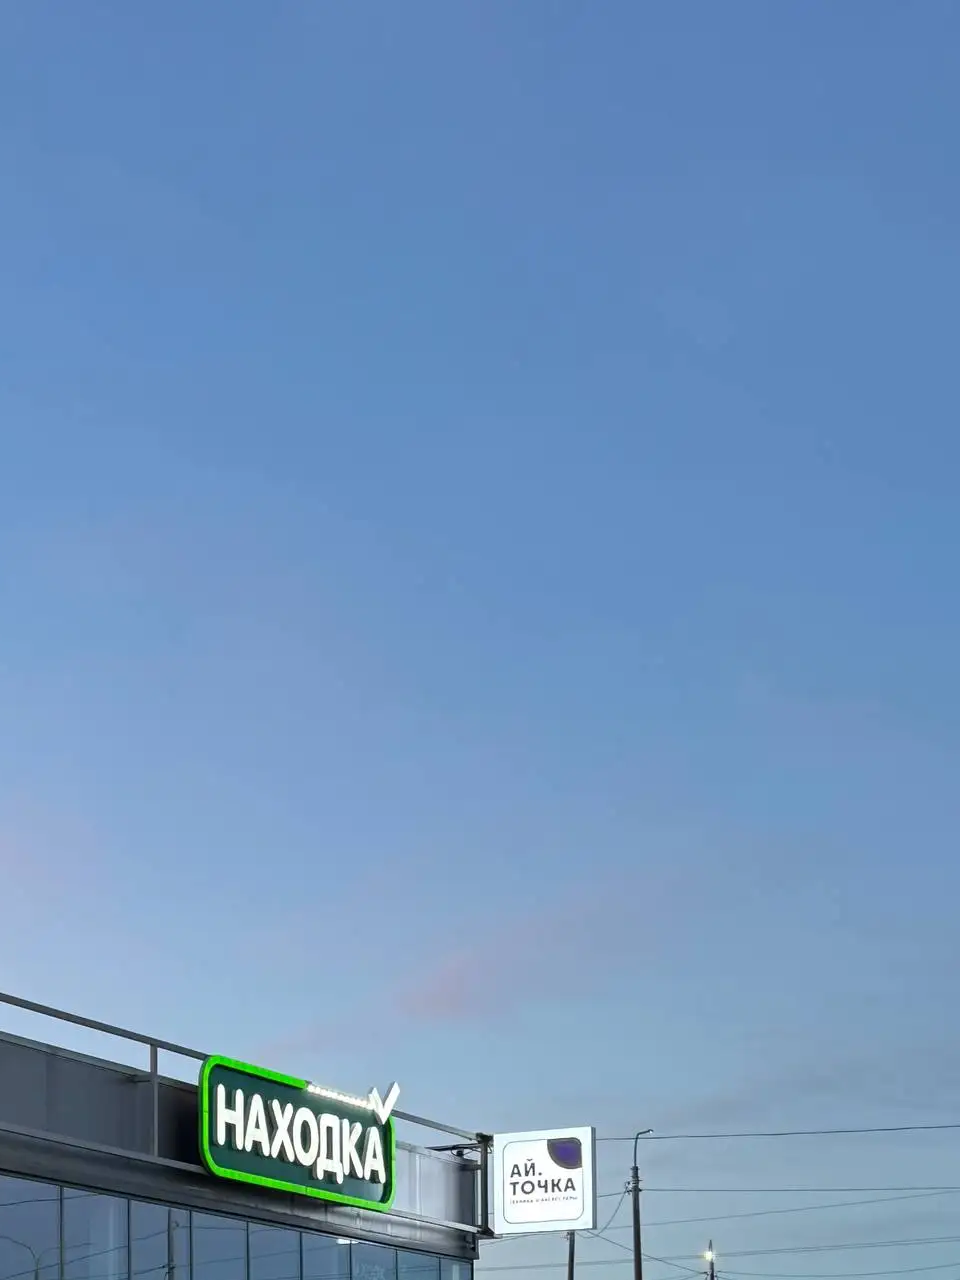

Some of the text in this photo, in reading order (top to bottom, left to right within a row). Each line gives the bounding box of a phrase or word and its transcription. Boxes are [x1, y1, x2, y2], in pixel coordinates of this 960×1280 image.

[215, 1083, 387, 1184] НАХОДКА
[510, 1158, 543, 1178] АЙ.
[509, 1177, 577, 1196] ТОЧКА
